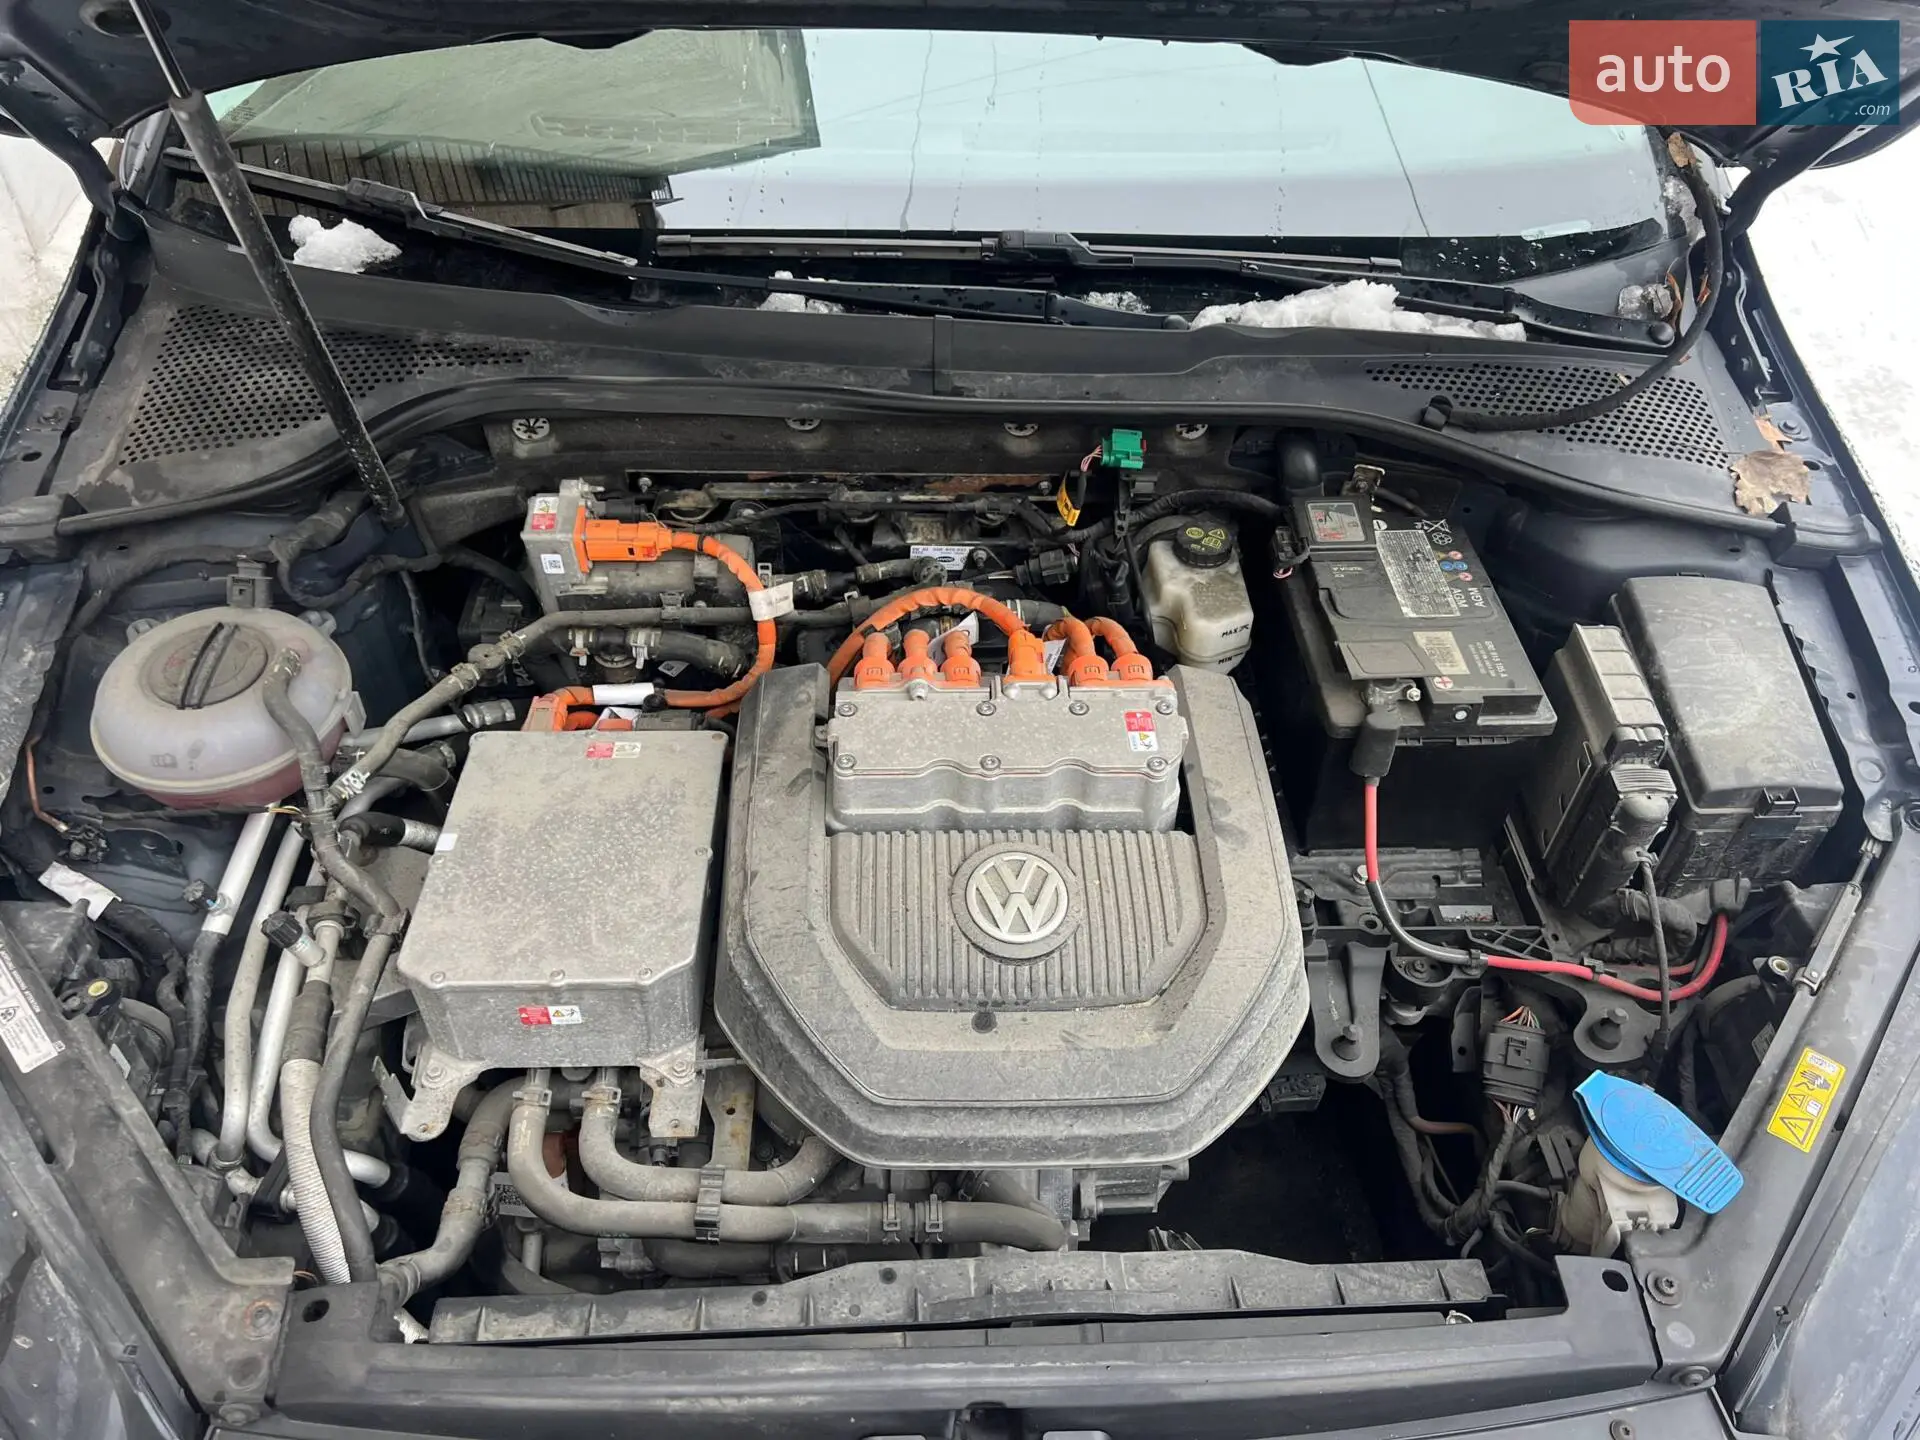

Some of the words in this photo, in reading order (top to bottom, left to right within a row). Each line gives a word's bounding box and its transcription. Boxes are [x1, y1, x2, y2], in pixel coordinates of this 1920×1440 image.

[1450, 587, 1469, 608] AGM
[1467, 587, 1487, 608] AGM
[1221, 627, 1238, 638] MAX
[1217, 656, 1233, 665] MIN
[967, 853, 1066, 942] VW
